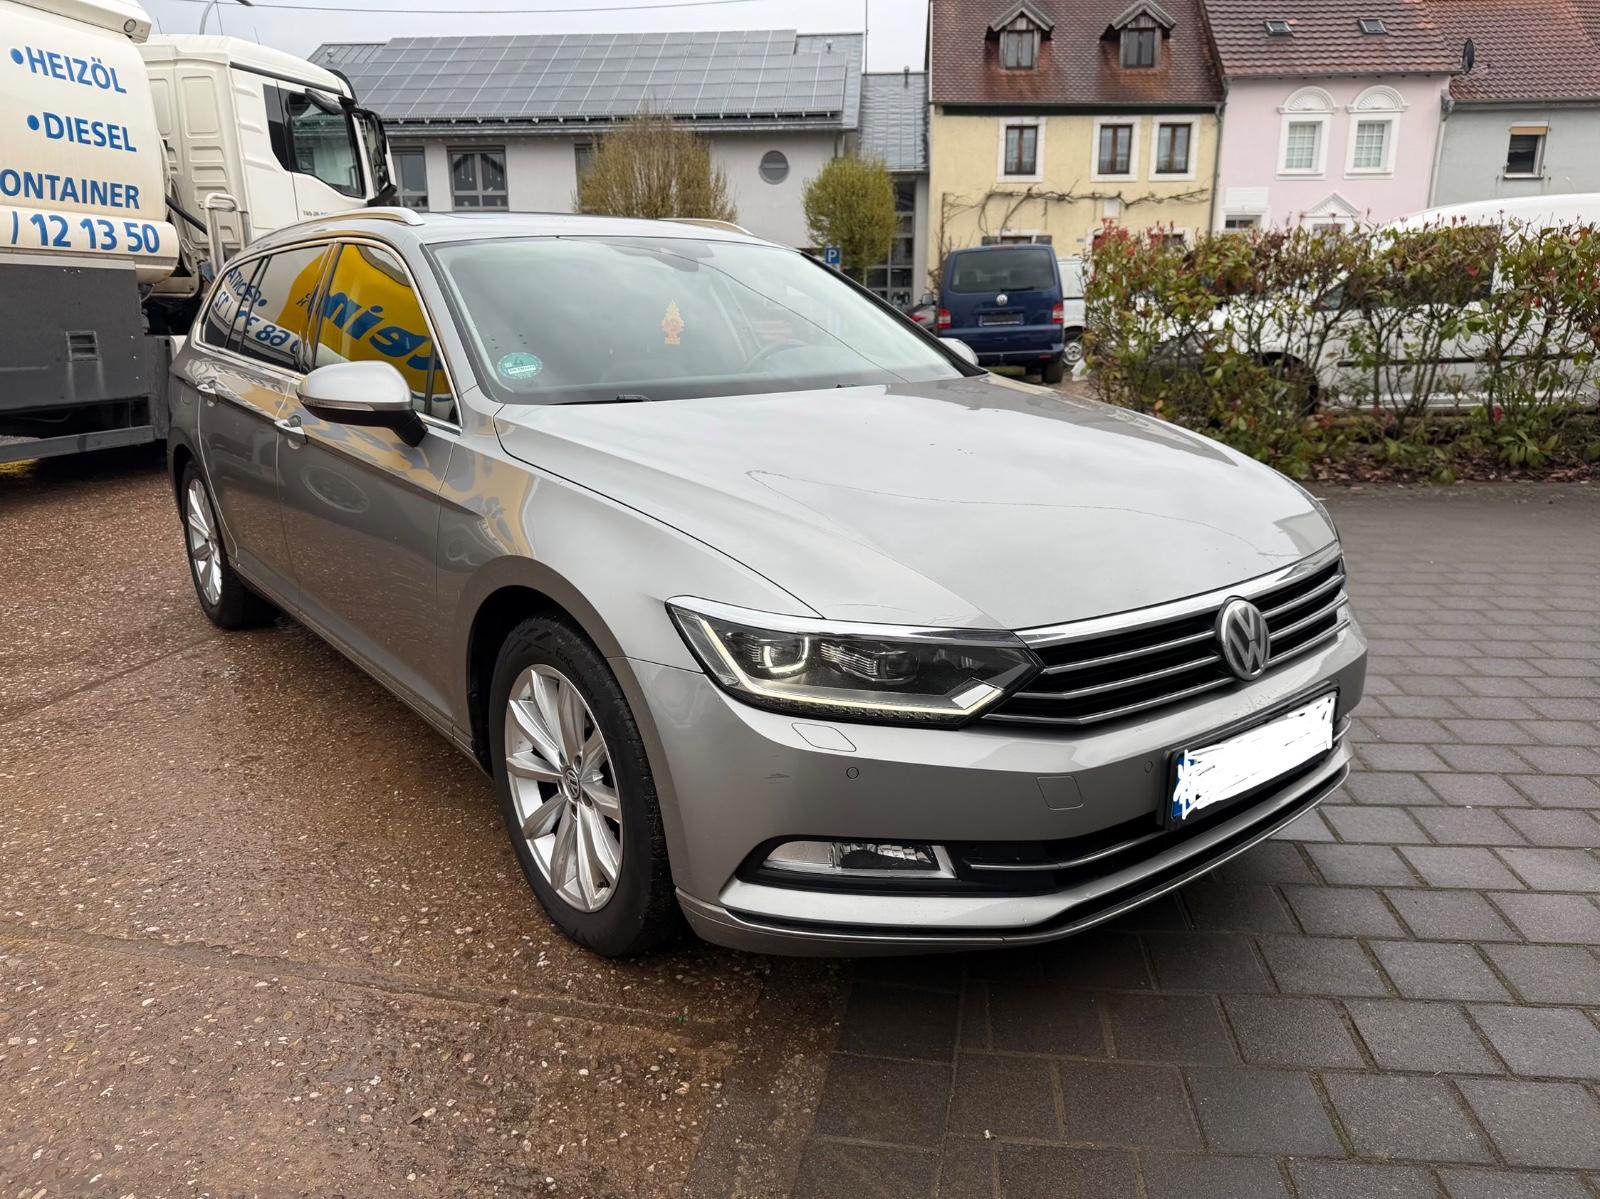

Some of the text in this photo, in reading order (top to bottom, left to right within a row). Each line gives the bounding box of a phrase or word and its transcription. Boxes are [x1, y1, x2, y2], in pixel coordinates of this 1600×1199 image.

[25, 46, 127, 94] HEIZÖL
[43, 112, 137, 152] DIESEL
[0, 169, 140, 209] ONTAINER
[30, 213, 71, 248] 12
[80, 218, 117, 251] 13
[123, 222, 160, 253] 50
[828, 249, 837, 263] P
[1221, 599, 1270, 681] VW
